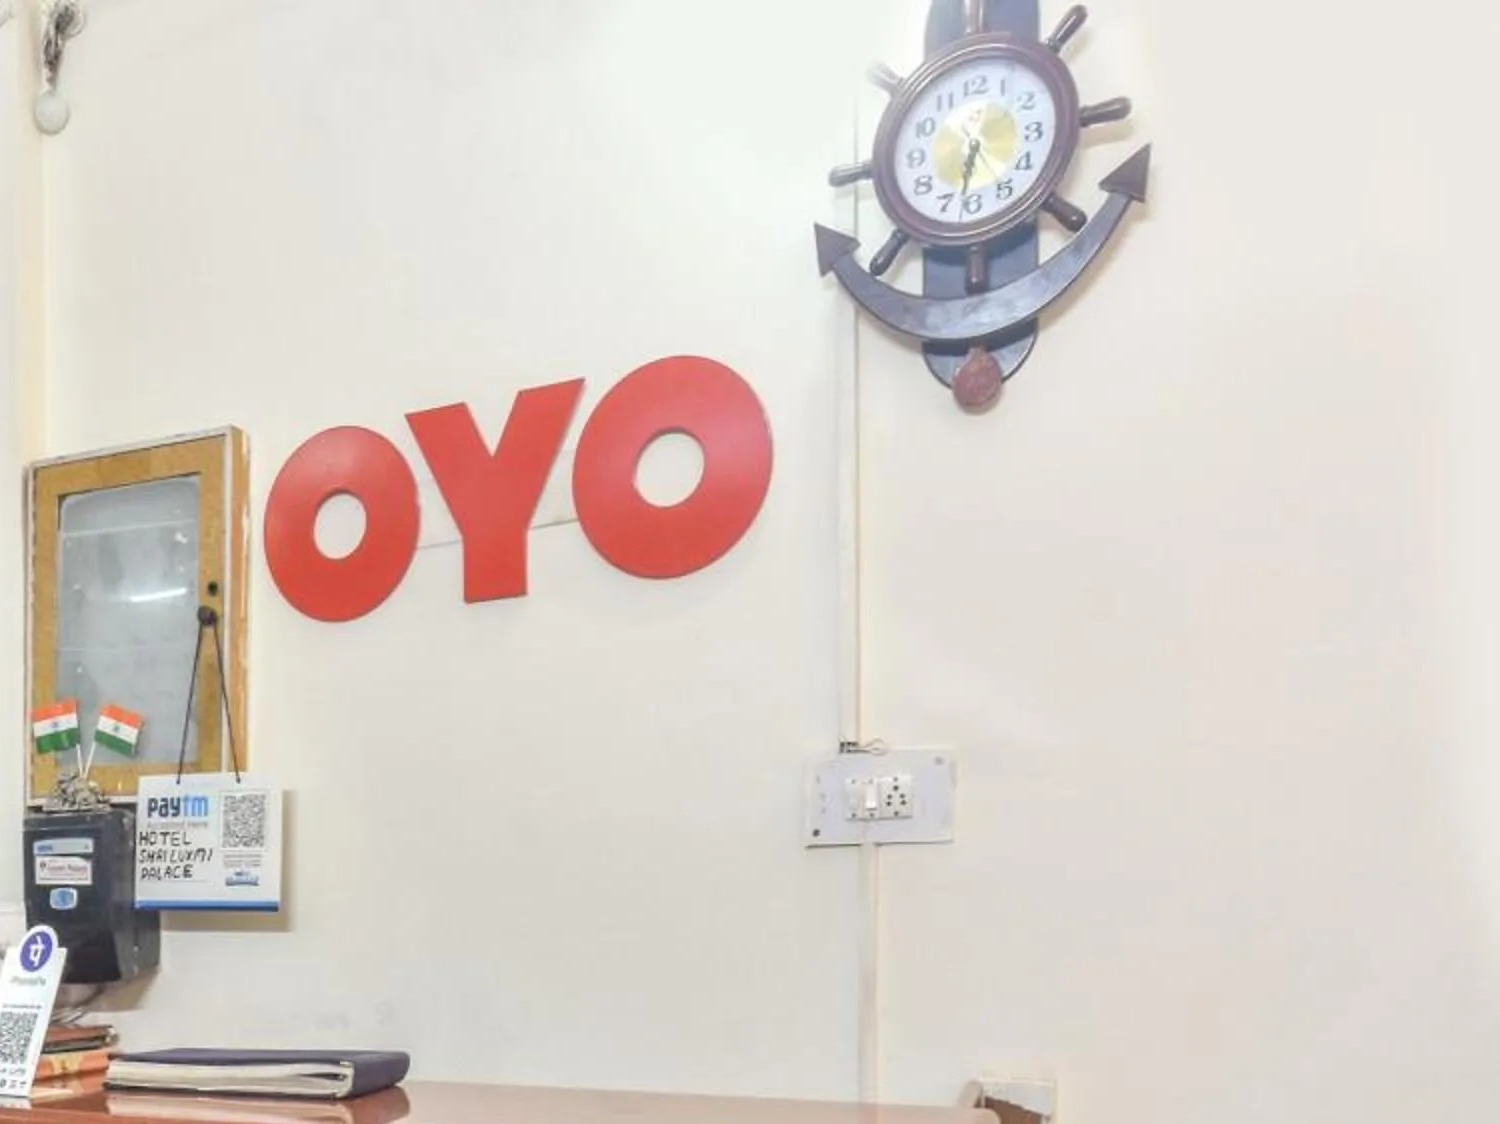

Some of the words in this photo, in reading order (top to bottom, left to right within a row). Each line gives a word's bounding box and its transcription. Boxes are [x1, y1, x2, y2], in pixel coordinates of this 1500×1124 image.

[963, 75, 989, 97] 12
[1001, 78, 1006, 96] 1
[936, 92, 954, 112] 11
[1018, 91, 1036, 110] 2
[915, 117, 936, 139] 10
[1024, 121, 1043, 142] 3
[906, 150, 926, 168] 9
[1014, 152, 1032, 171] 4
[913, 175, 933, 195] 8
[996, 178, 1013, 199] 5
[936, 193, 954, 213] 7
[964, 194, 983, 214] 6
[264, 355, 774, 622] OYO
[138, 831, 191, 846] HOTEL
[141, 864, 194, 881] PALACE
